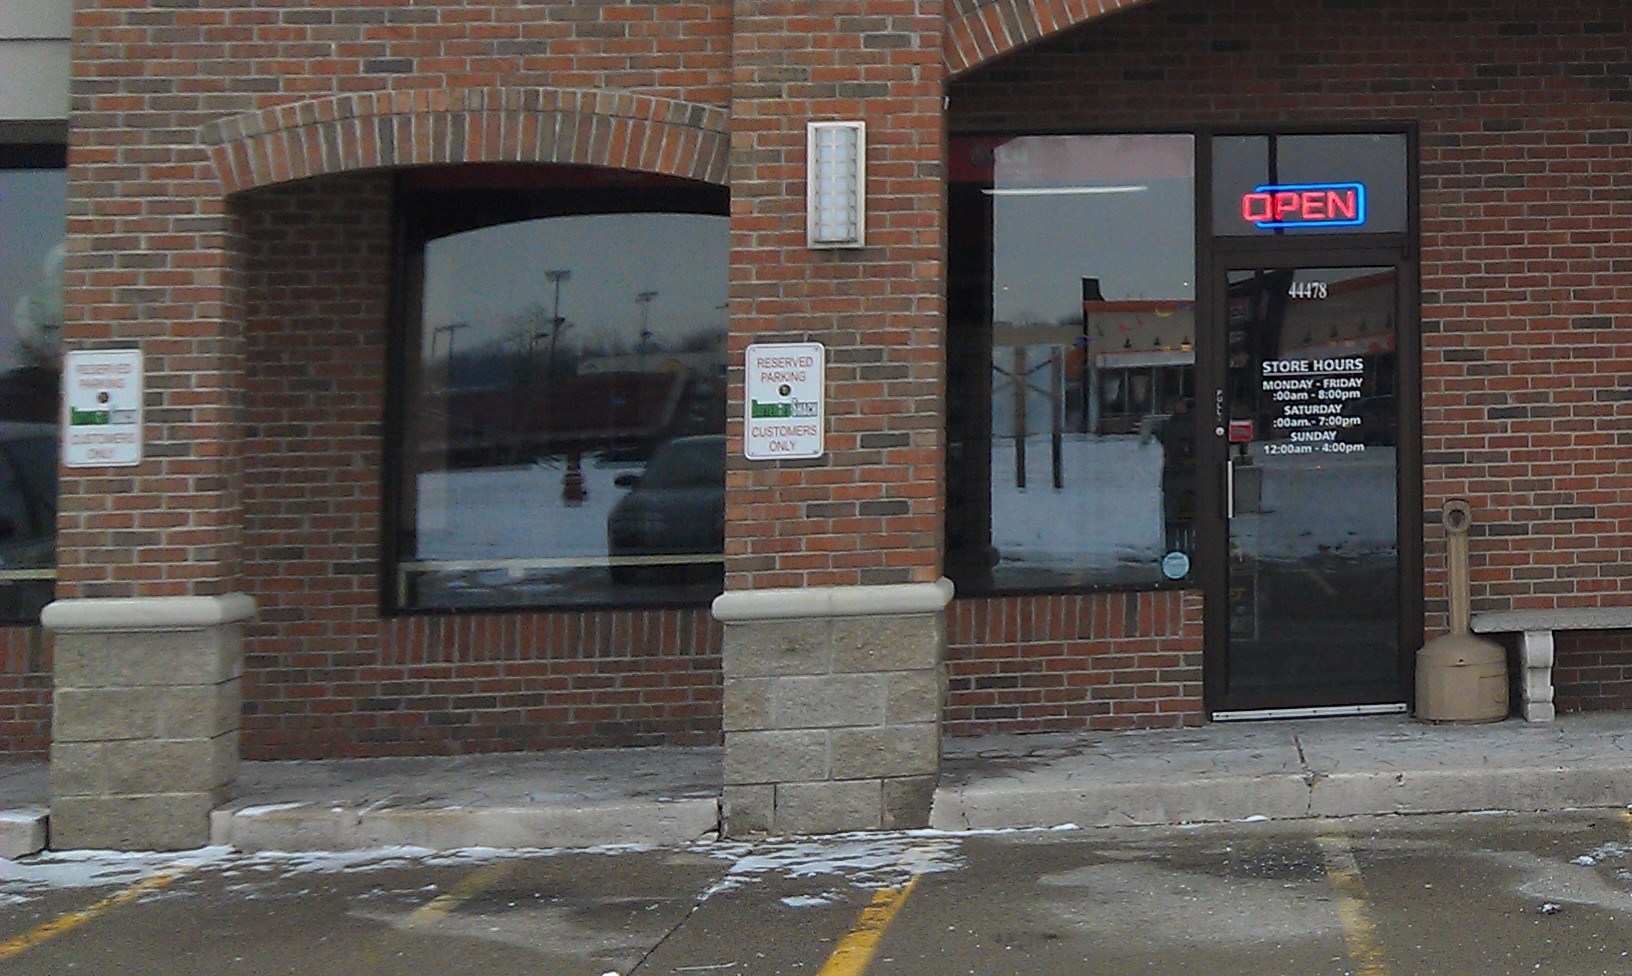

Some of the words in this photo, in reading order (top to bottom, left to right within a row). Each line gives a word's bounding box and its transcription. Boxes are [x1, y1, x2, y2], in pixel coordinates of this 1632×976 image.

[1241, 189, 1357, 222] OPEN
[1288, 282, 1328, 300] 44478
[757, 356, 814, 369] RESERVED
[1262, 360, 1310, 374] STORE
[1313, 358, 1364, 372] HOURS
[761, 371, 806, 383] PARKING
[1262, 379, 1314, 391] MONDAY
[1323, 377, 1364, 389] FRIDAY
[1318, 389, 1361, 401] 8:00pm
[1284, 404, 1343, 416] SATURDAY
[1318, 415, 1362, 429] 7:00pm
[751, 424, 818, 438] CUSTOMERS
[1290, 430, 1338, 442] SUNDAY
[768, 440, 796, 453] ONLY
[1264, 444, 1312, 455] 12:00am
[1321, 442, 1365, 454] 4:00pm
